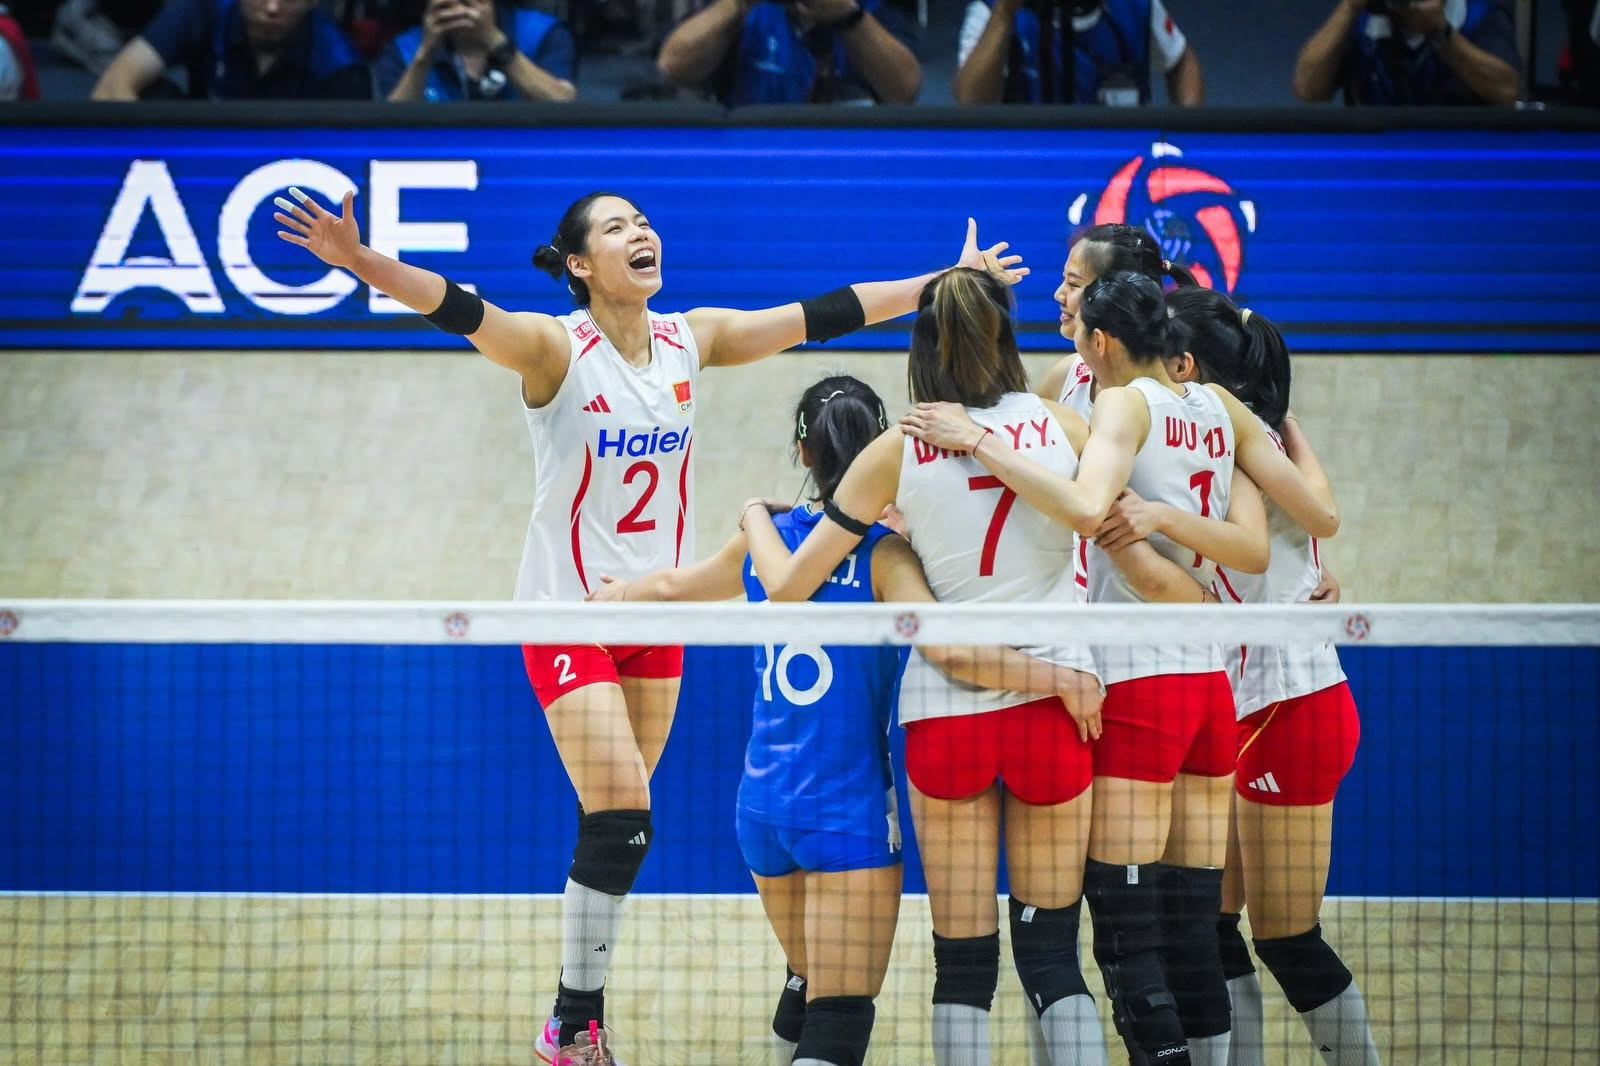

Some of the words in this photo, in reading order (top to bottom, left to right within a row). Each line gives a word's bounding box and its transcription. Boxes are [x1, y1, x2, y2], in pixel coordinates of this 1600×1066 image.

[70, 158, 478, 315] ACE
[597, 425, 689, 458] Haier
[1166, 416, 1197, 451] WU
[616, 461, 659, 534] 2
[968, 475, 1017, 577] 7
[1189, 469, 1215, 568] 1
[554, 653, 577, 686] 2
